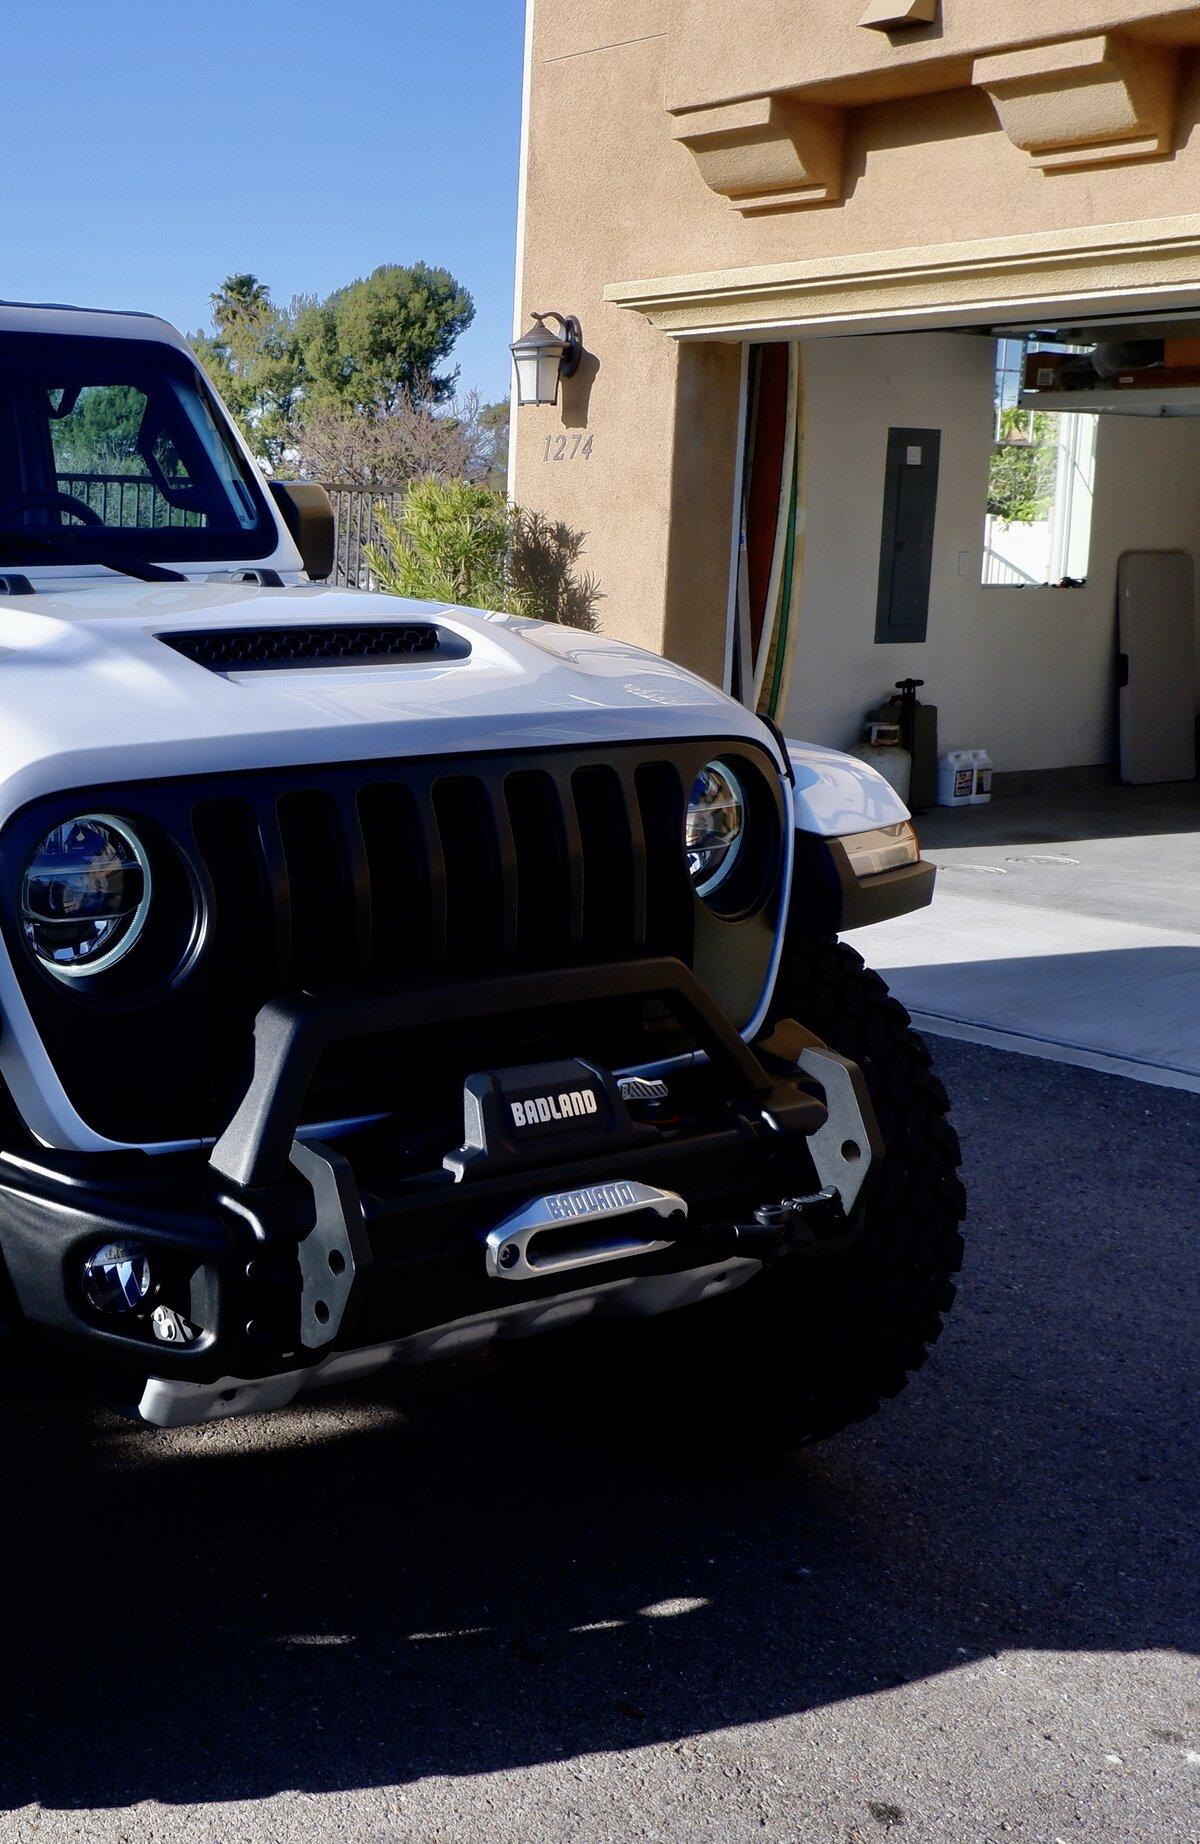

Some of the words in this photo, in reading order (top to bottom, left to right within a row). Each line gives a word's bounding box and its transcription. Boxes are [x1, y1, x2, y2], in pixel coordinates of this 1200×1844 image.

[543, 434, 594, 461] 1274
[511, 1089, 598, 1127] BADLAND
[545, 1183, 636, 1220] BADLAND
